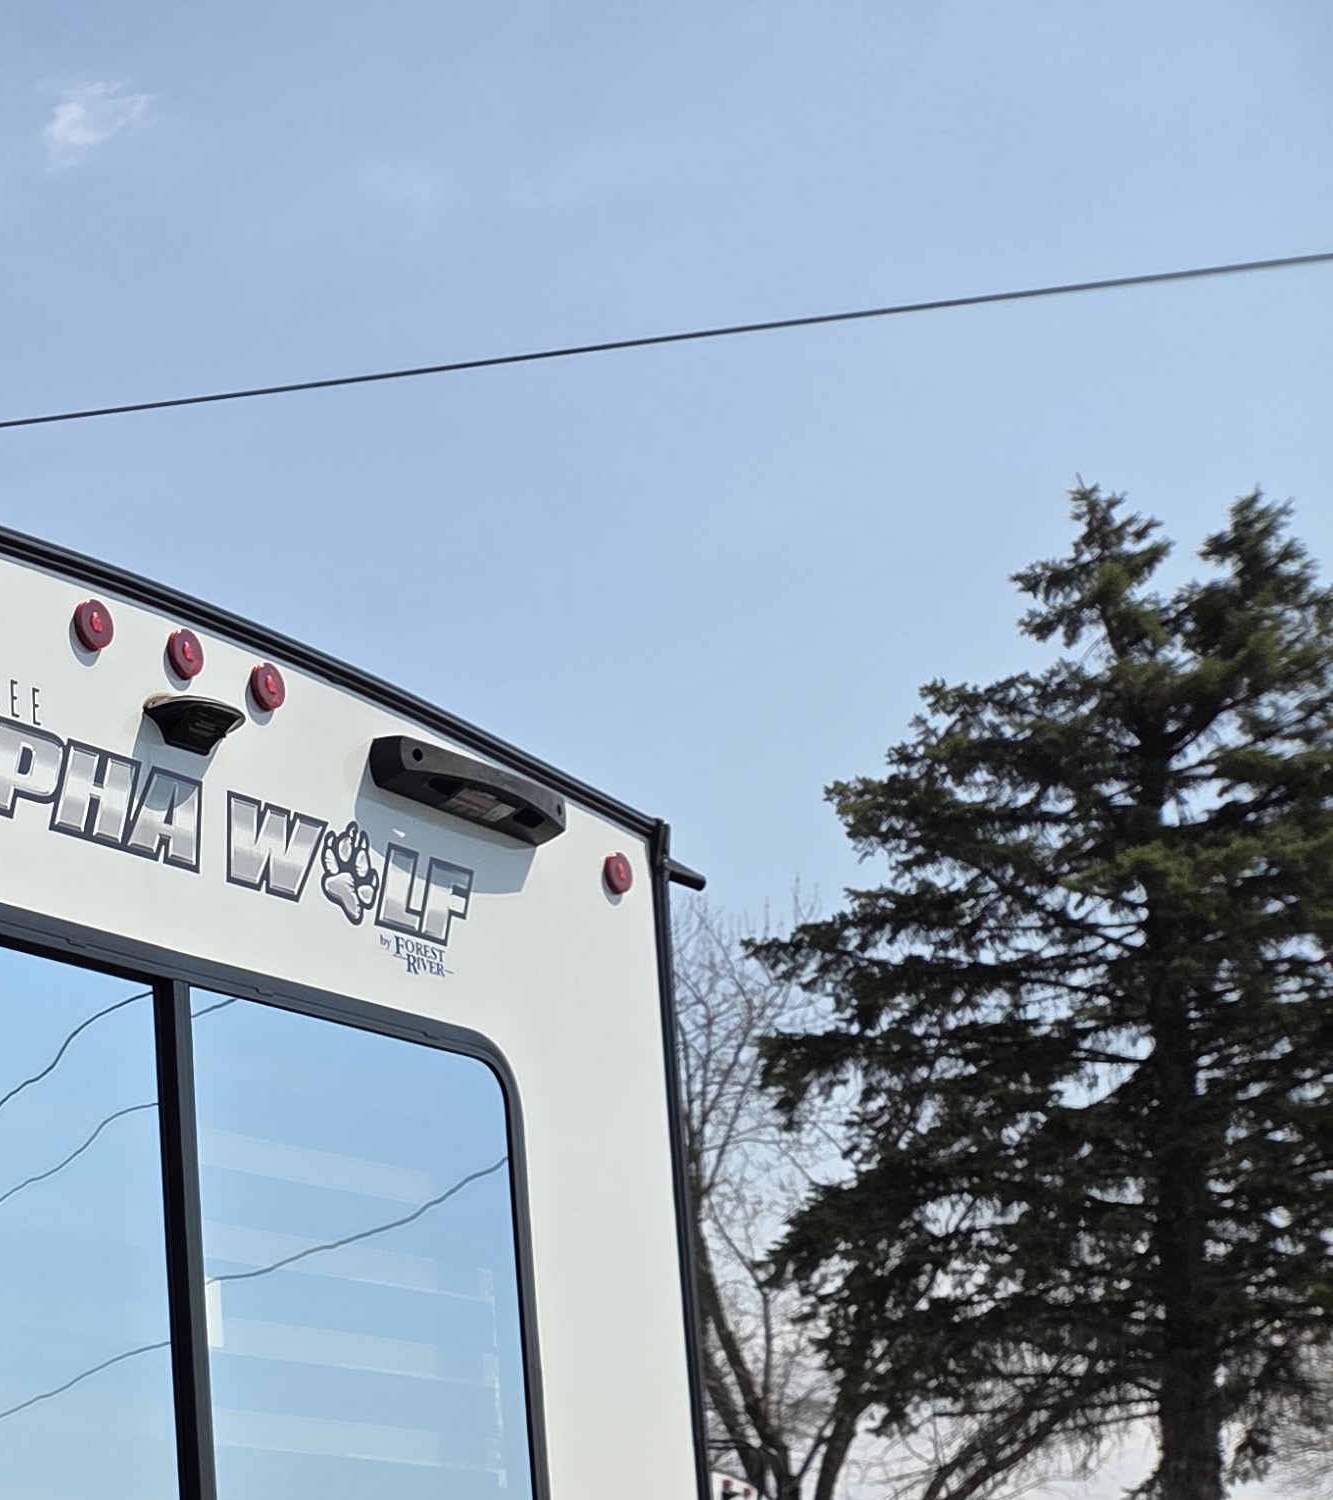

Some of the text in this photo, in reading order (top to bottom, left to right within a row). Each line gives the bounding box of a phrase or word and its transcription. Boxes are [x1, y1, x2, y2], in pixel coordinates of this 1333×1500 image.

[379, 933, 446, 963] by FOREST
[406, 953, 446, 978] RIVER
